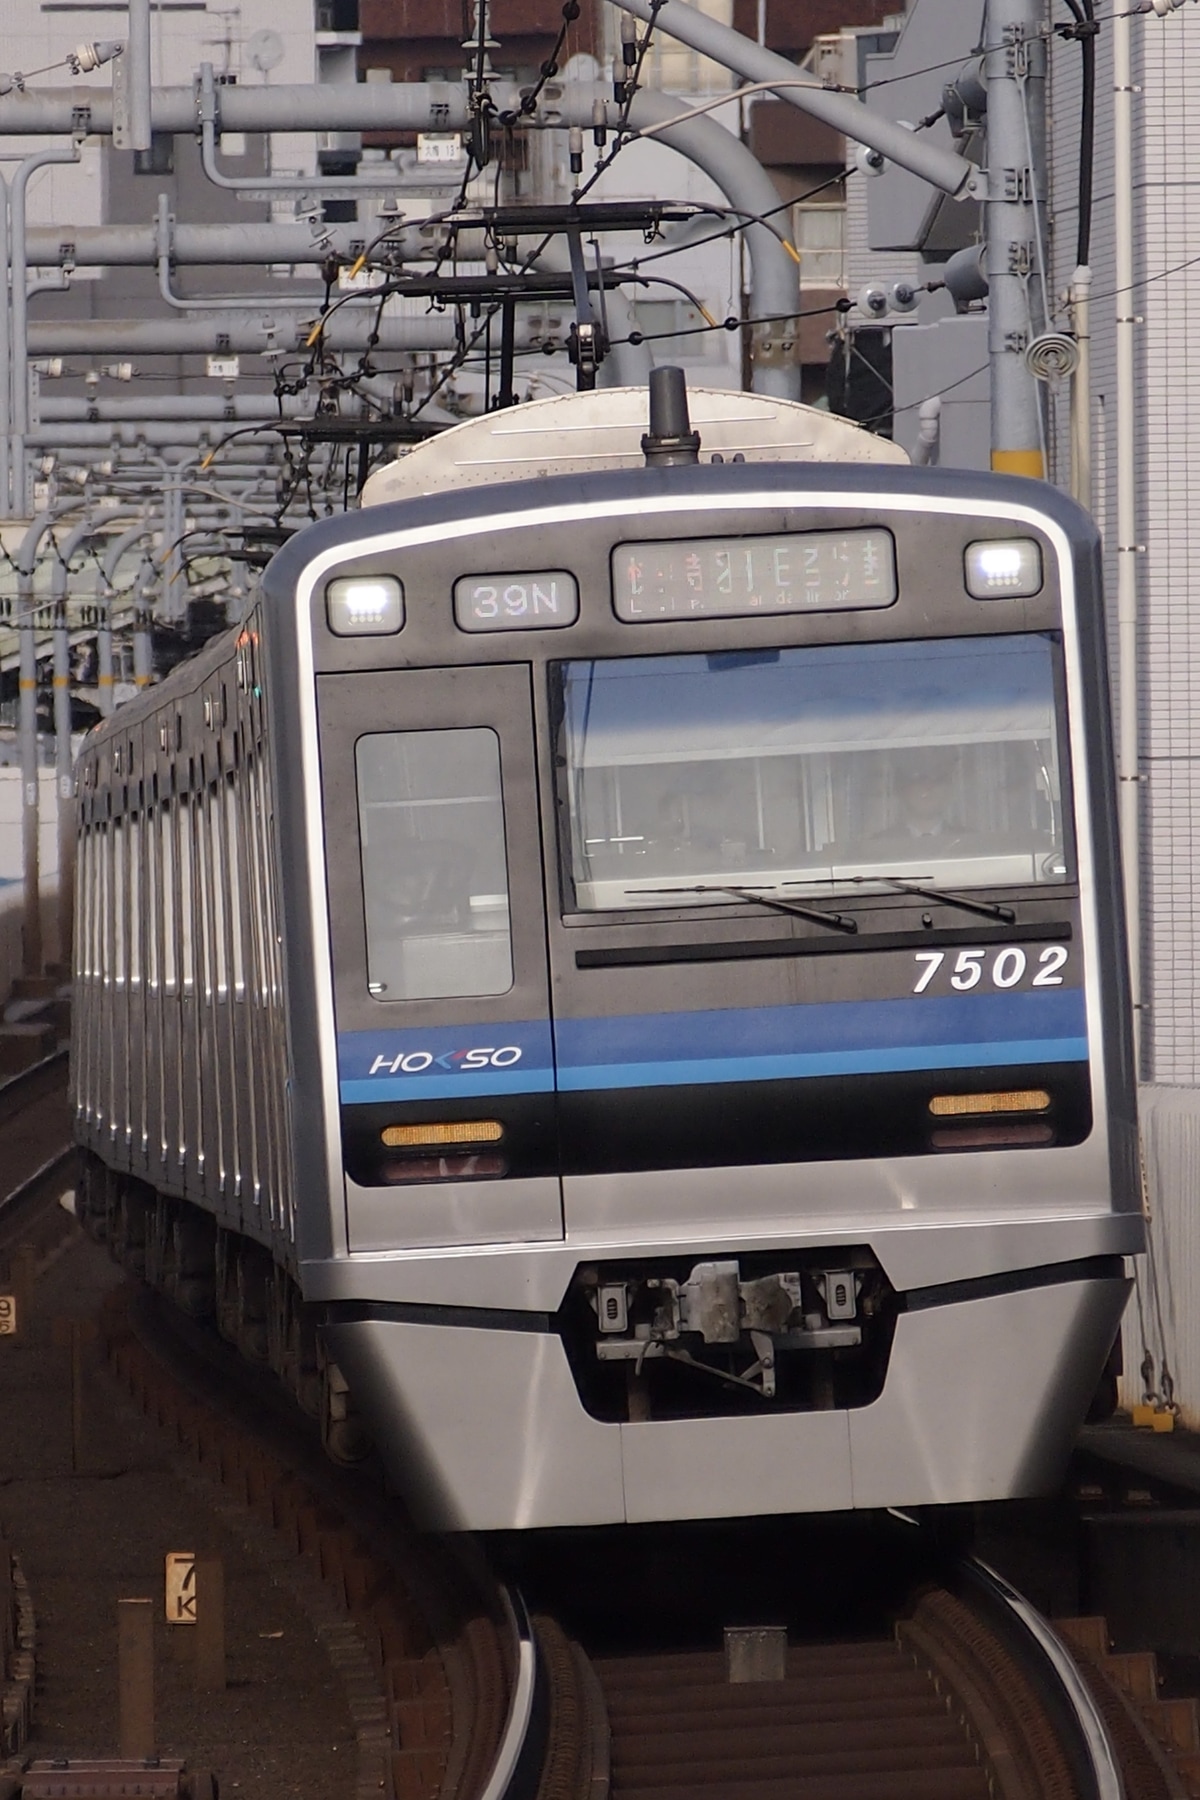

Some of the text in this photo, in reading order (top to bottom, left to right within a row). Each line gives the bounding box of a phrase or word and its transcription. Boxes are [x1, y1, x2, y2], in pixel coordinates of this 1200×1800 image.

[473, 581, 558, 618] 39N
[912, 945, 1069, 994] 7502
[174, 1558, 196, 1591] 7
[177, 1595, 197, 1617] K
